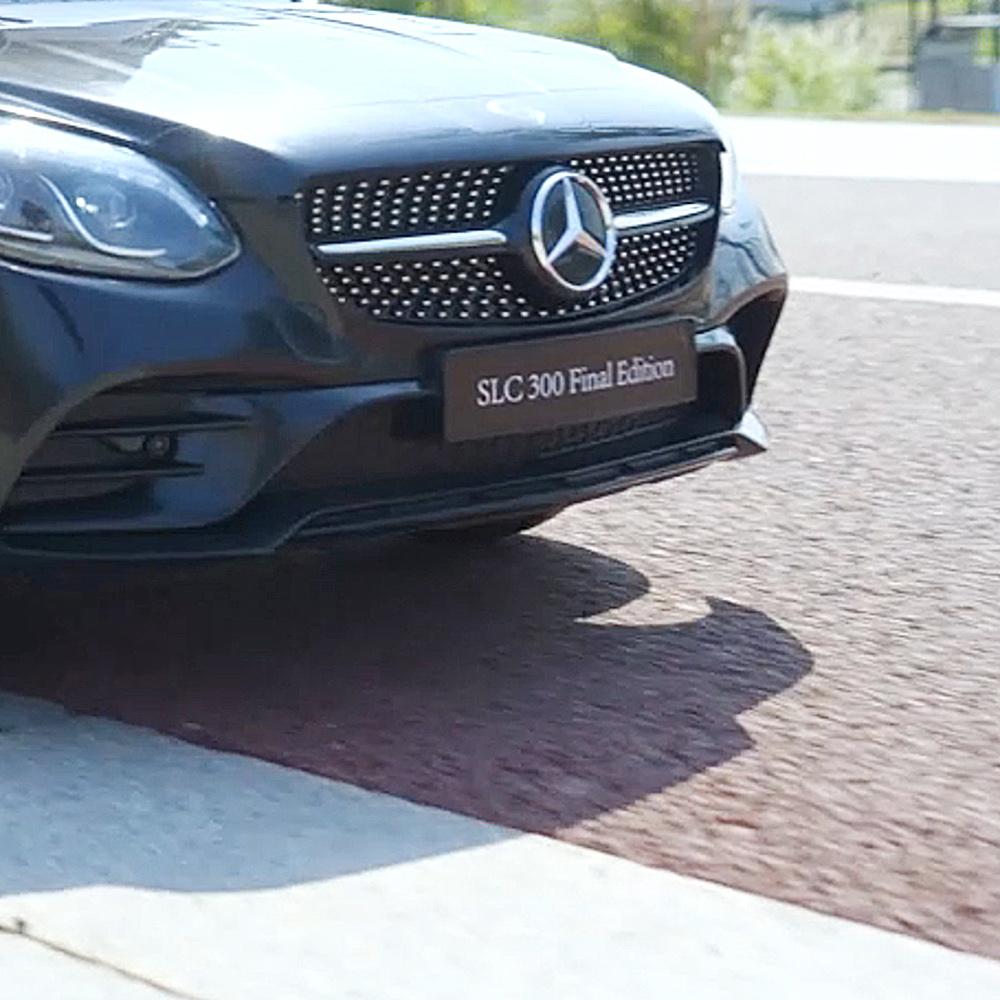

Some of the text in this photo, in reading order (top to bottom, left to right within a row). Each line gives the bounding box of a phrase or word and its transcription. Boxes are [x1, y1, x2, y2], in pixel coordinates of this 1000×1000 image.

[476, 355, 676, 407] SLC 300 Final Edition
